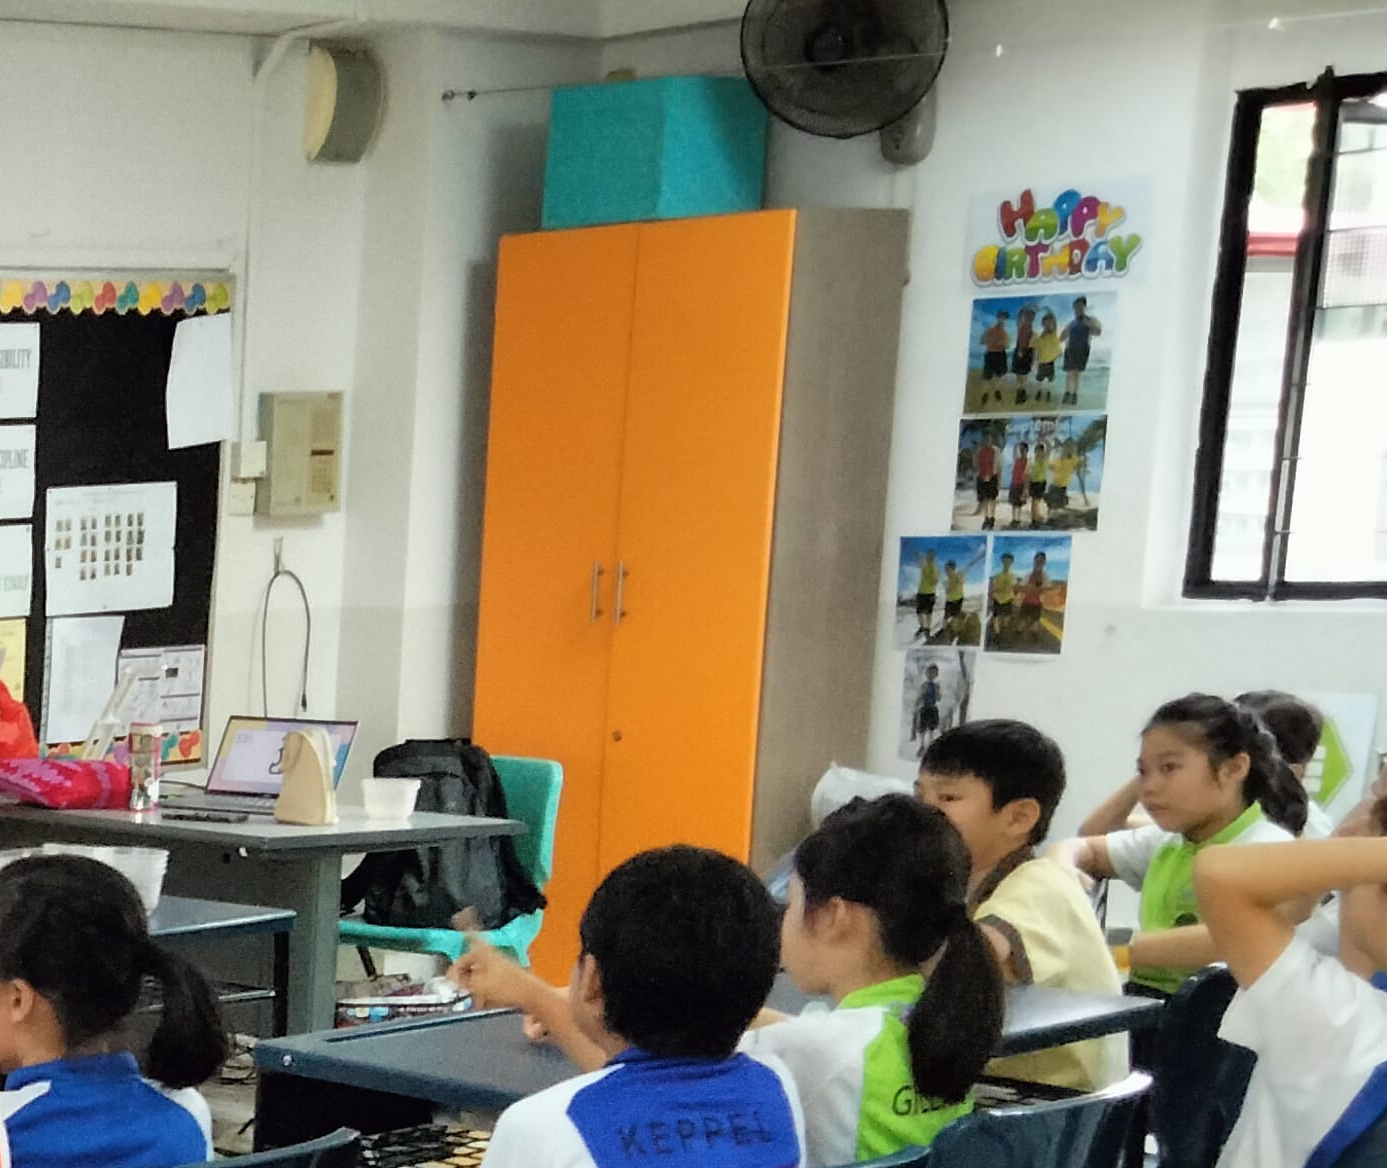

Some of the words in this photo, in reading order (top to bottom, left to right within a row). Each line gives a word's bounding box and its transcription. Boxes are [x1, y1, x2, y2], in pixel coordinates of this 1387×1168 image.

[999, 188, 1126, 238] HAPPY
[973, 233, 1141, 283] BIRTHDAY
[616, 1109, 774, 1157] KEPPEL
